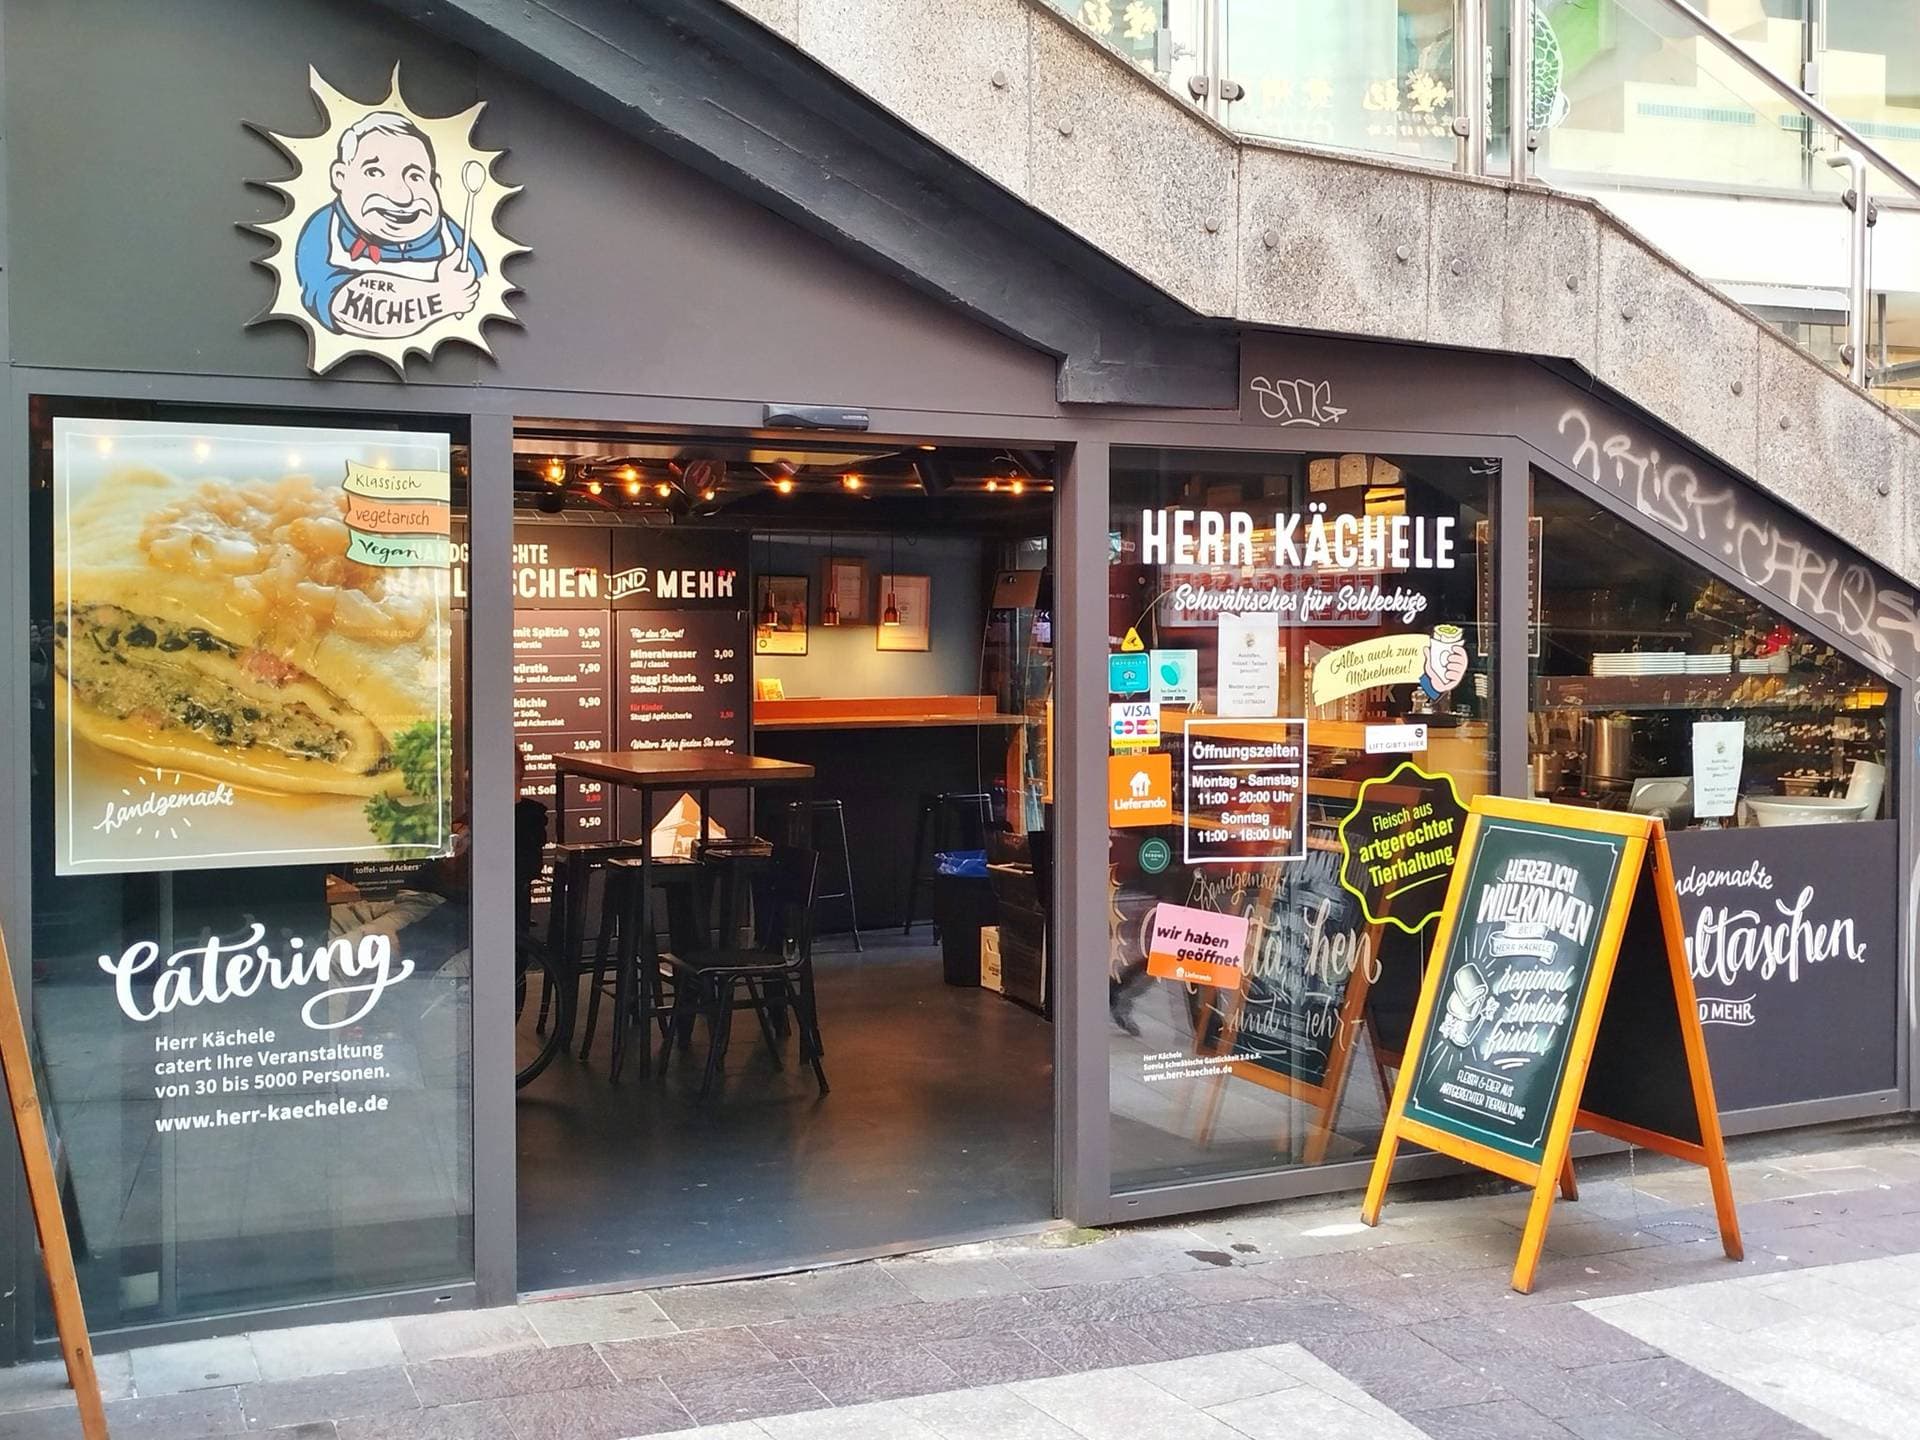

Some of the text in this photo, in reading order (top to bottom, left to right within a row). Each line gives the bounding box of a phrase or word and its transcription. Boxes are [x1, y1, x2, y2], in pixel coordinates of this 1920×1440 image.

[359, 278, 396, 293] HERR
[355, 474, 422, 490] Klassisch
[356, 508, 430, 528] vegetarisch
[1142, 502, 1456, 570] HERR KÄCHELE
[358, 538, 420, 563] Vegan
[607, 571, 646, 595] UND
[656, 569, 734, 598] MEHR
[1174, 583, 1428, 624] Schwäbisches für Schleckige
[630, 649, 734, 659] Mineralwasser 3,00
[1367, 644, 1393, 663] auch
[1396, 646, 1418, 659] zum
[579, 663, 600, 674] 7,90
[1346, 658, 1413, 685] Mitnehmen!
[630, 673, 734, 686] Stuggi Schorle 3,50
[579, 697, 601, 709] 9,90
[1122, 705, 1152, 717] VISA
[573, 740, 601, 751] 10,90
[1192, 743, 1299, 761] Öffnungszeiten
[579, 783, 601, 795] 5,90
[1192, 776, 1238, 790] Montag
[1248, 774, 1299, 789] Samstag
[1114, 797, 1167, 811] Lieferando
[1197, 793, 1229, 805] 11:00
[1239, 791, 1271, 804] 20:00
[1272, 790, 1295, 803] Uhr
[579, 816, 601, 828] 9,50
[1221, 812, 1270, 826] Sonntag
[1372, 803, 1434, 833] Fleisch aus
[1197, 831, 1229, 843] 11:00
[1359, 817, 1455, 864] artgerechter
[1368, 845, 1456, 888] Tierhaltung
[1505, 859, 1579, 894] HERZLICH
[1476, 883, 1595, 947] WILLKOMMEN
[1157, 926, 1229, 948] wir haben
[1176, 948, 1239, 967] geöffnet
[98, 922, 416, 1030] Catering
[1493, 964, 1575, 1000] regional
[1504, 992, 1568, 1028] ehrlich
[1711, 1003, 1754, 1020] MEHR
[155, 1027, 276, 1052] Herr Kächele
[154, 1043, 384, 1076] catert Ihre Veranstaltung
[1143, 1050, 1182, 1061] Herr Kächele
[154, 1065, 390, 1099] von 30 bis 5000 Personen.
[1143, 1064, 1233, 1082] www.herr-kaechele.de
[155, 1094, 389, 1133] www.herr-kaechele.de
